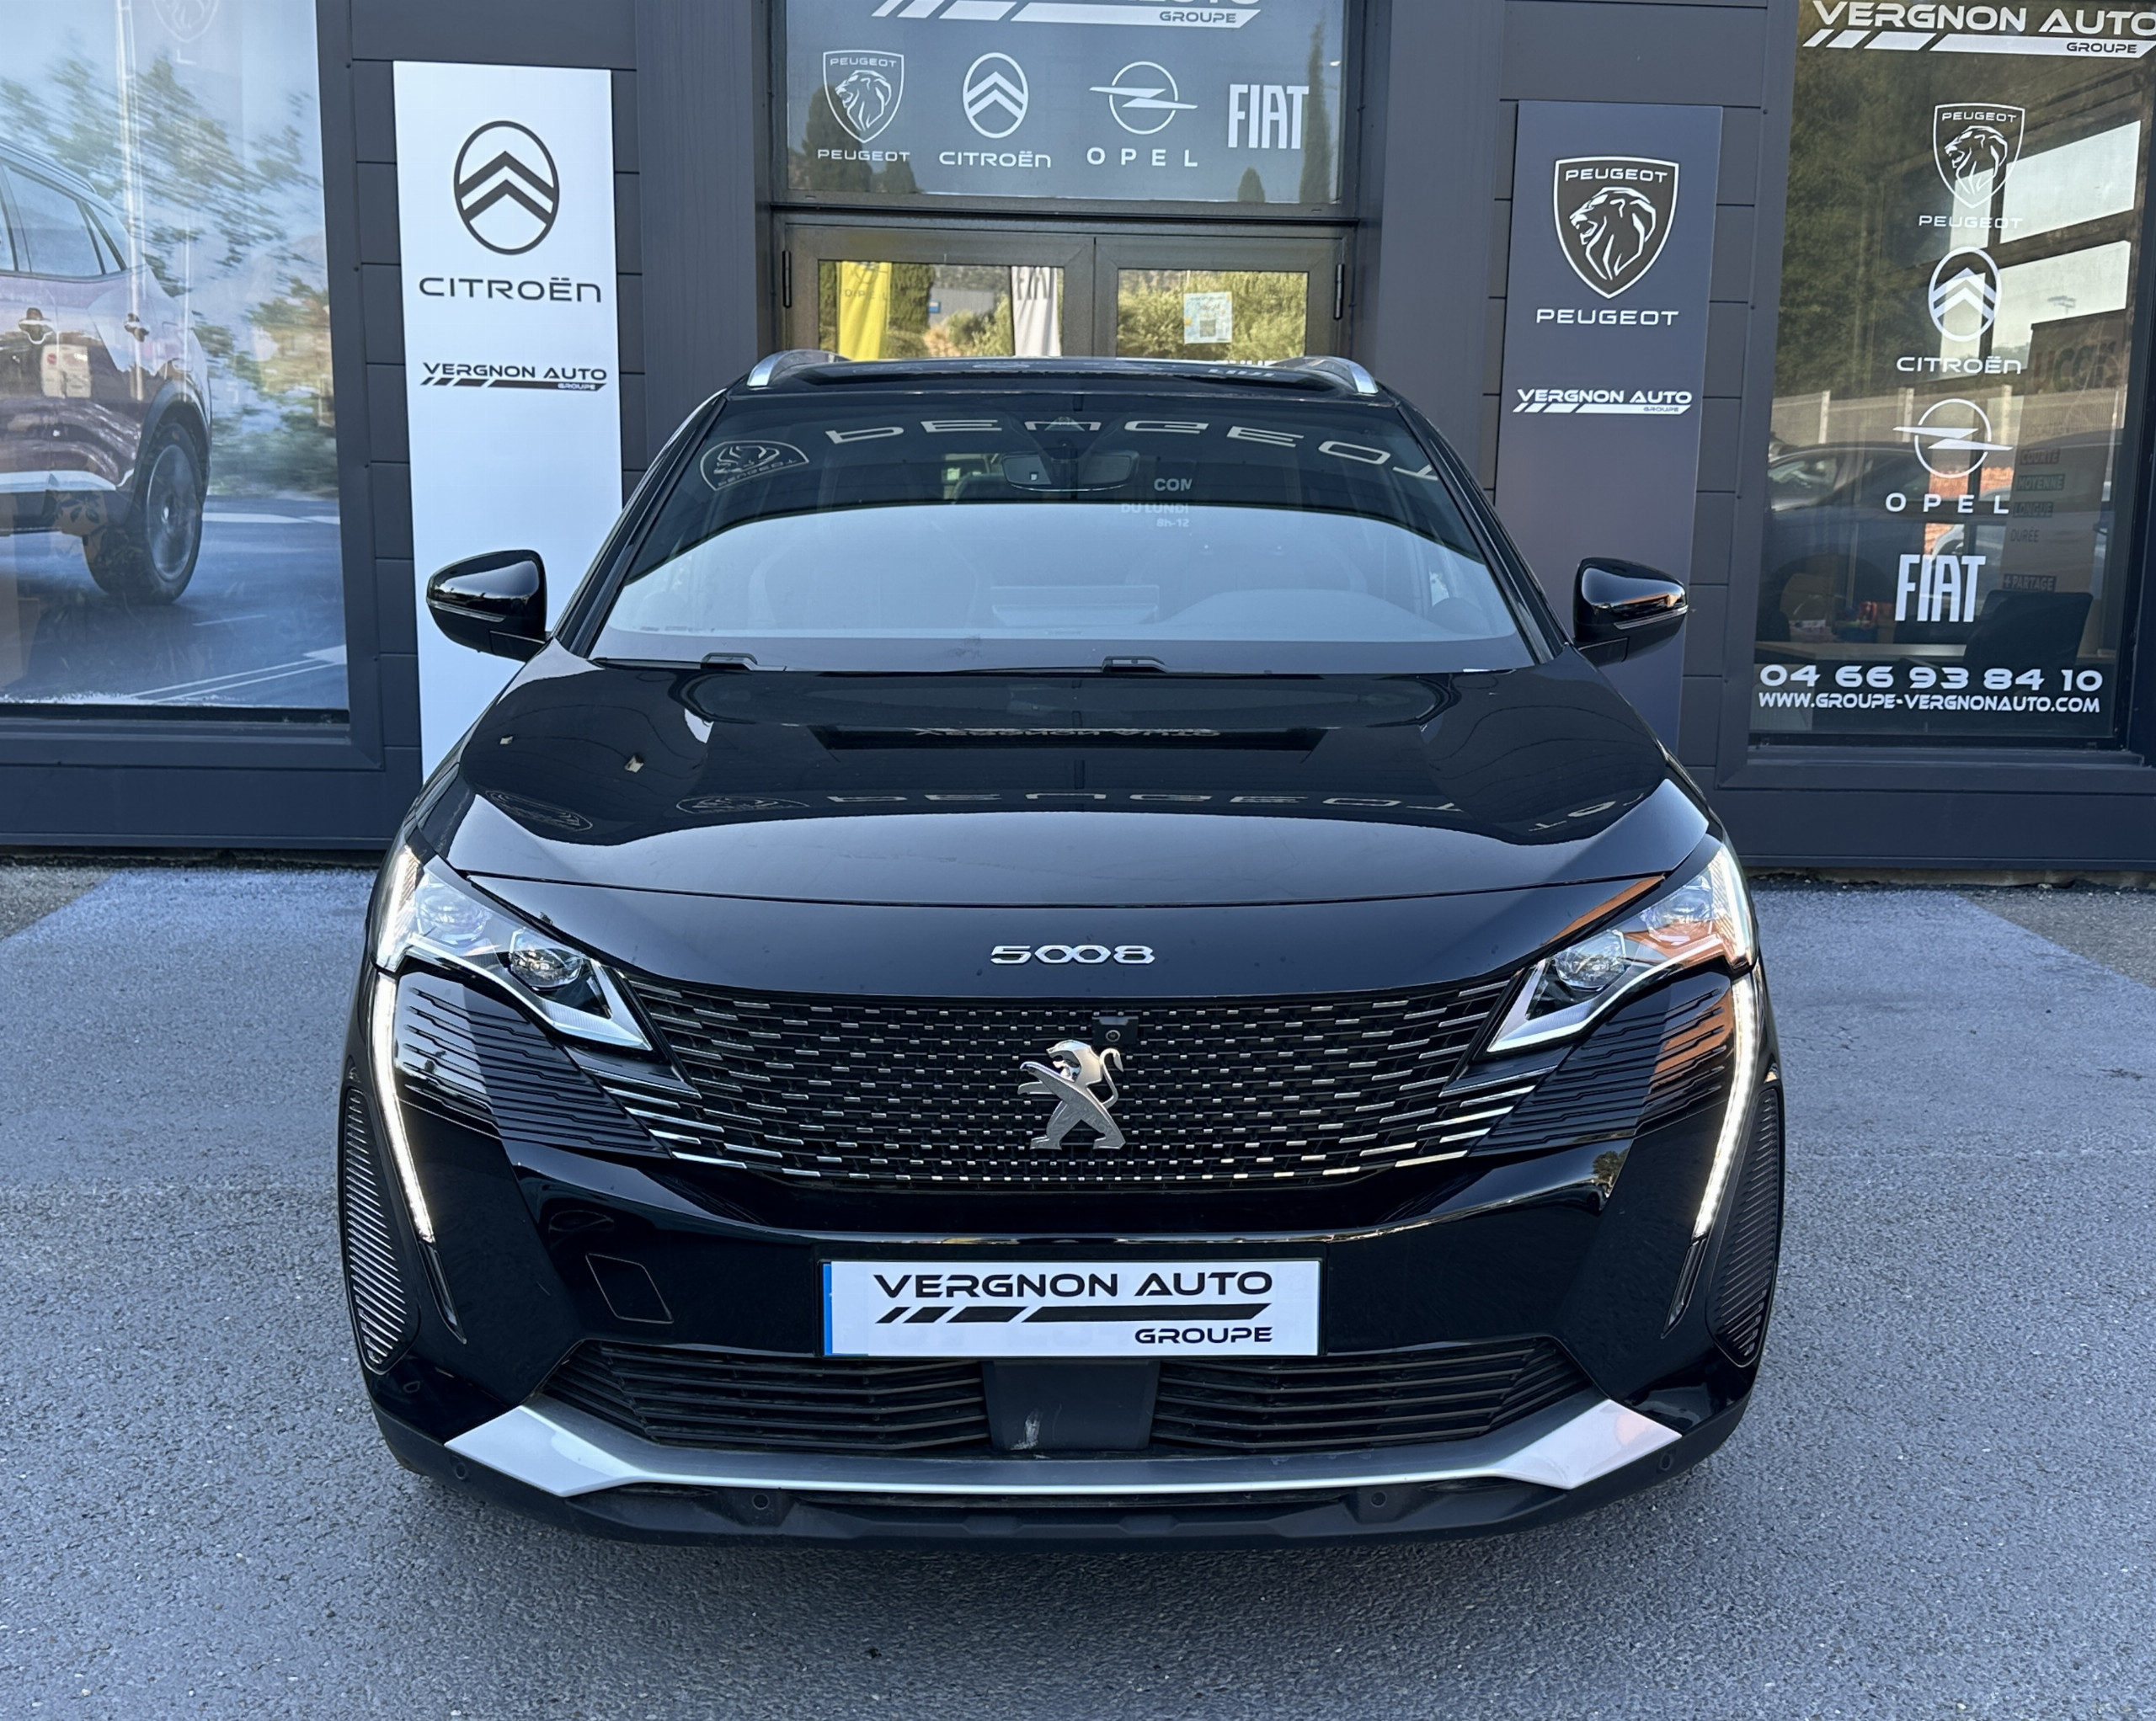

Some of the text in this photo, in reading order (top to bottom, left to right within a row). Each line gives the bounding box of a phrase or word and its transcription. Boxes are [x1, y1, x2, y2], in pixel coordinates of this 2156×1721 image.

[1159, 10, 1237, 24] GROUPE
[1812, 0, 2156, 36] VERGNON AUTO
[2066, 41, 2138, 54] GROUPE
[830, 57, 897, 68] PEUGEOT
[1228, 84, 1310, 150] FIAT
[1941, 111, 2018, 124] PEUGEOT
[817, 148, 911, 163] PEUGEOT
[938, 150, 1052, 168] CITROËN
[1086, 147, 1198, 168] OPEL
[1565, 168, 1668, 183] PEUGEOT
[1918, 215, 2024, 230] PEUGEOT
[419, 276, 602, 303] CITROËN
[1535, 308, 1679, 326] PEUGEOT
[422, 361, 608, 381] VERGNON AUTO
[1896, 355, 2022, 375] CITROËN
[557, 382, 596, 391] GROUPE
[1517, 389, 1693, 405] VERGNON AUTO
[1885, 493, 2009, 514] OPEL
[1894, 554, 1986, 622] FIAT
[1759, 664, 2103, 692] 04 66 93 84 10
[1758, 692, 2100, 713] WWW.GROUPE-VERGNONAUTO.COM
[990, 944, 1156, 967] 5008
[873, 1271, 1273, 1298] VERGNON AUTO
[1134, 1327, 1273, 1345] GROUPE
